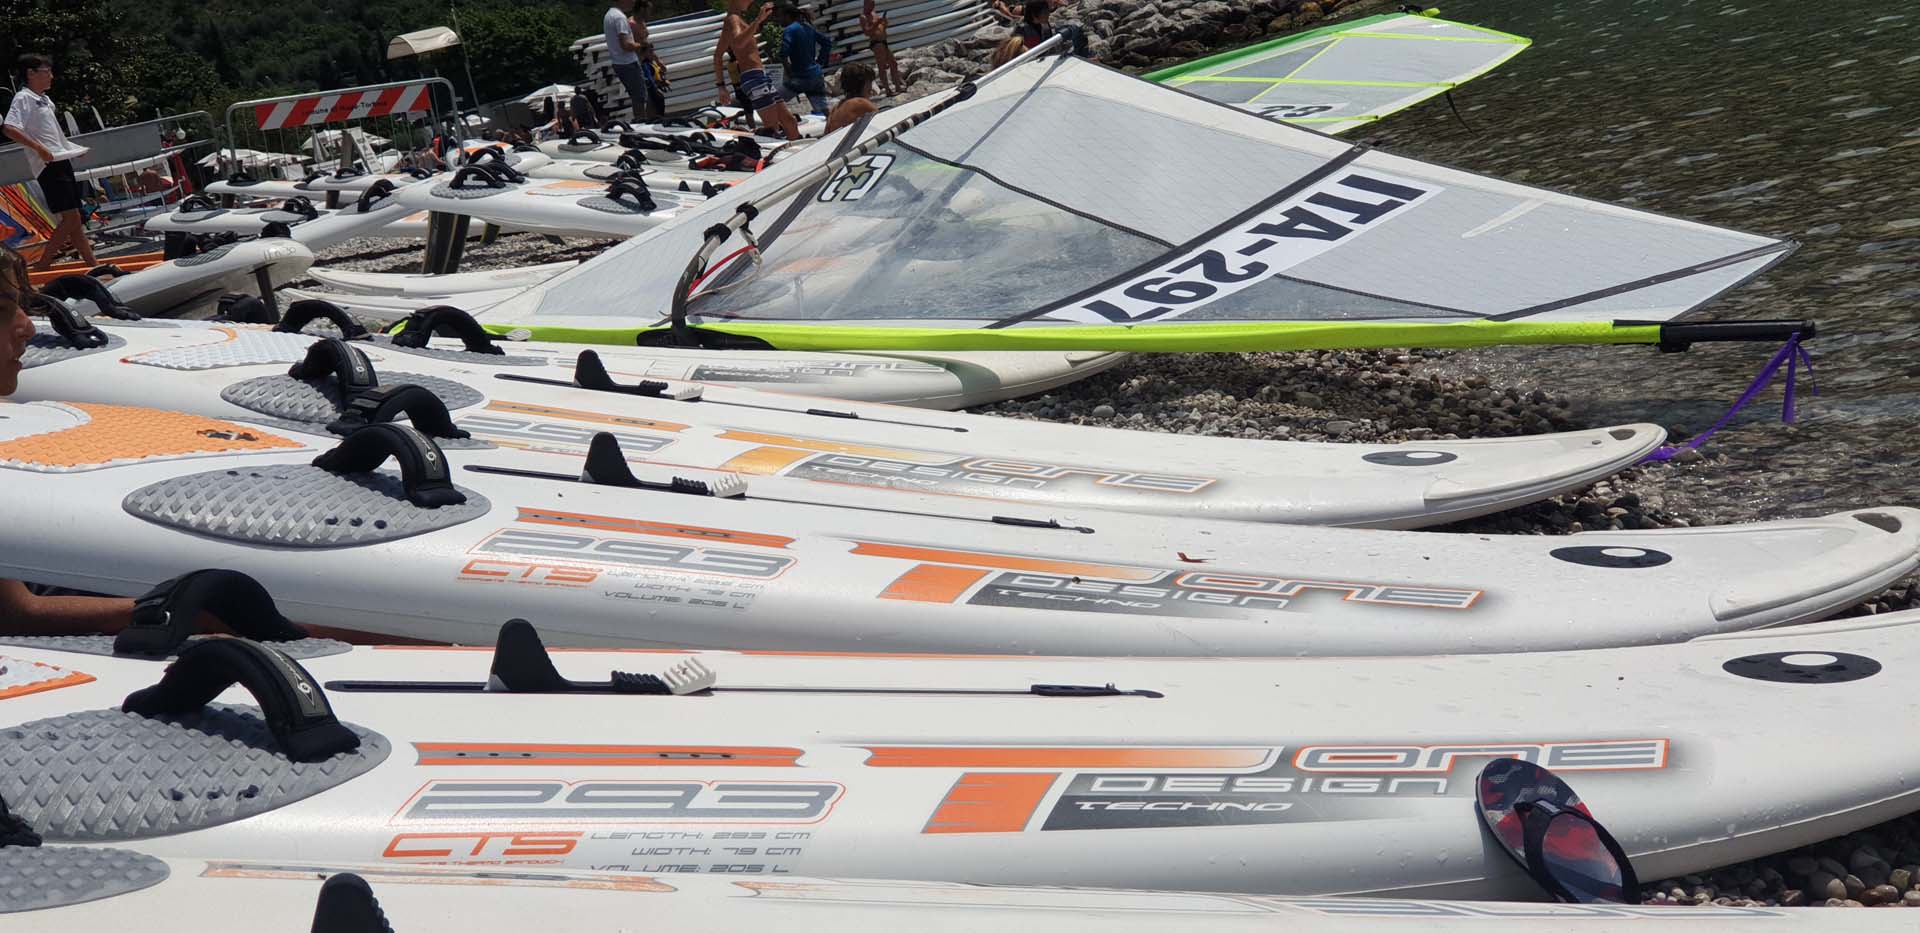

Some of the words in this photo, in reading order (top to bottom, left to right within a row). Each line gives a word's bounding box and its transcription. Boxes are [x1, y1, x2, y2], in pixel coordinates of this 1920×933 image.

[1081, 174, 1429, 323] ITA-297
[452, 415, 677, 452] 293
[810, 465, 939, 486] TECHNO
[826, 456, 1047, 489] DESIGN
[961, 459, 1218, 494] ONE
[478, 530, 794, 577] 293
[461, 559, 603, 583] CTS
[997, 588, 1162, 609] TECHNO
[1010, 575, 1289, 609] DESIGN
[1174, 572, 1485, 609] ONE
[1293, 739, 1670, 773] ONE
[1091, 776, 1447, 794] DESIGN
[404, 783, 839, 819] 293
[1076, 801, 1293, 811] TECHNO
[382, 831, 585, 858] CTS
[590, 831, 705, 841] LENGTH:
[712, 831, 768, 840] 293
[775, 831, 812, 840] CM
[631, 846, 712, 856] WIDTH:
[722, 846, 758, 856] 79
[765, 846, 803, 856] CM
[590, 863, 702, 874] VOLUME:
[709, 863, 767, 874] 205
[771, 863, 790, 874] L
